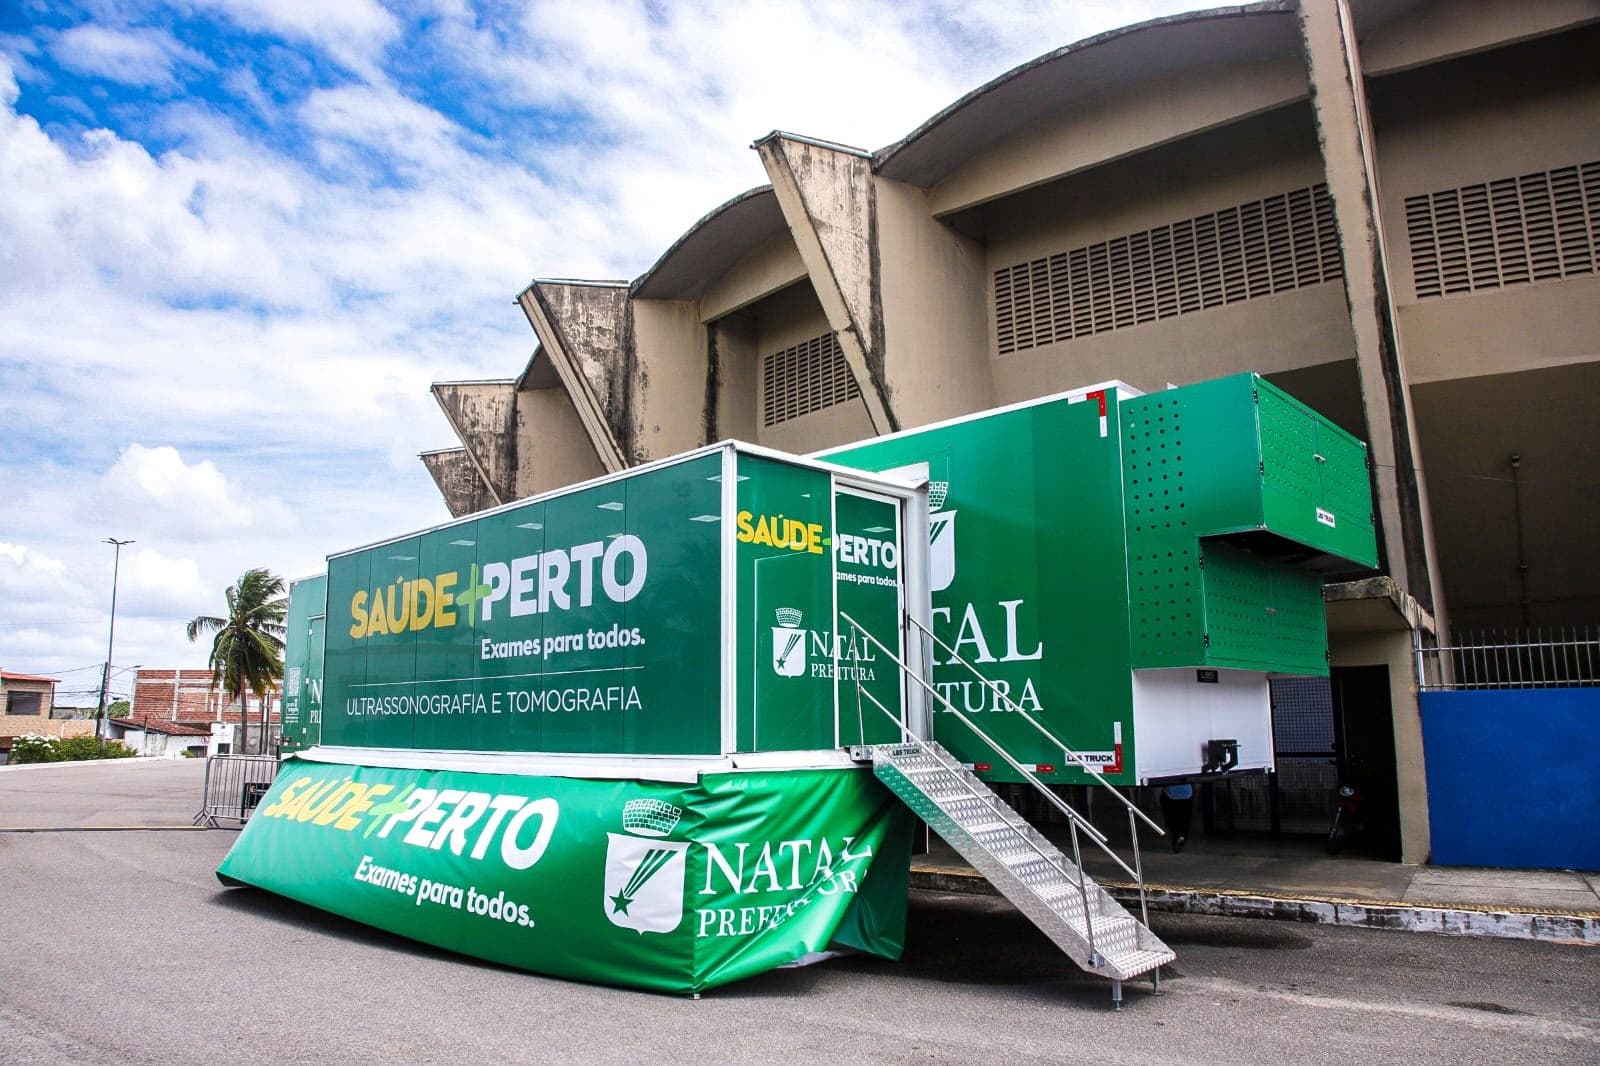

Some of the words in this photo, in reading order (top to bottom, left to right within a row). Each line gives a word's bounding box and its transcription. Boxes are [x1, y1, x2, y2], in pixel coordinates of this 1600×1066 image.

[736, 510, 824, 554] SAÚDE
[857, 574, 875, 586] para
[481, 637, 541, 660] Exames
[543, 633, 583, 660] para
[587, 624, 646, 651] todos.
[810, 630, 876, 661] NTAL
[347, 692, 487, 716] ULTRASSONOGRAFIA
[492, 694, 502, 713] E
[506, 685, 642, 714] TOMOGRAFIA
[1085, 754, 1113, 762] TRUCK
[354, 855, 418, 896] Exames
[416, 879, 464, 910] para
[467, 885, 535, 928] todos.
